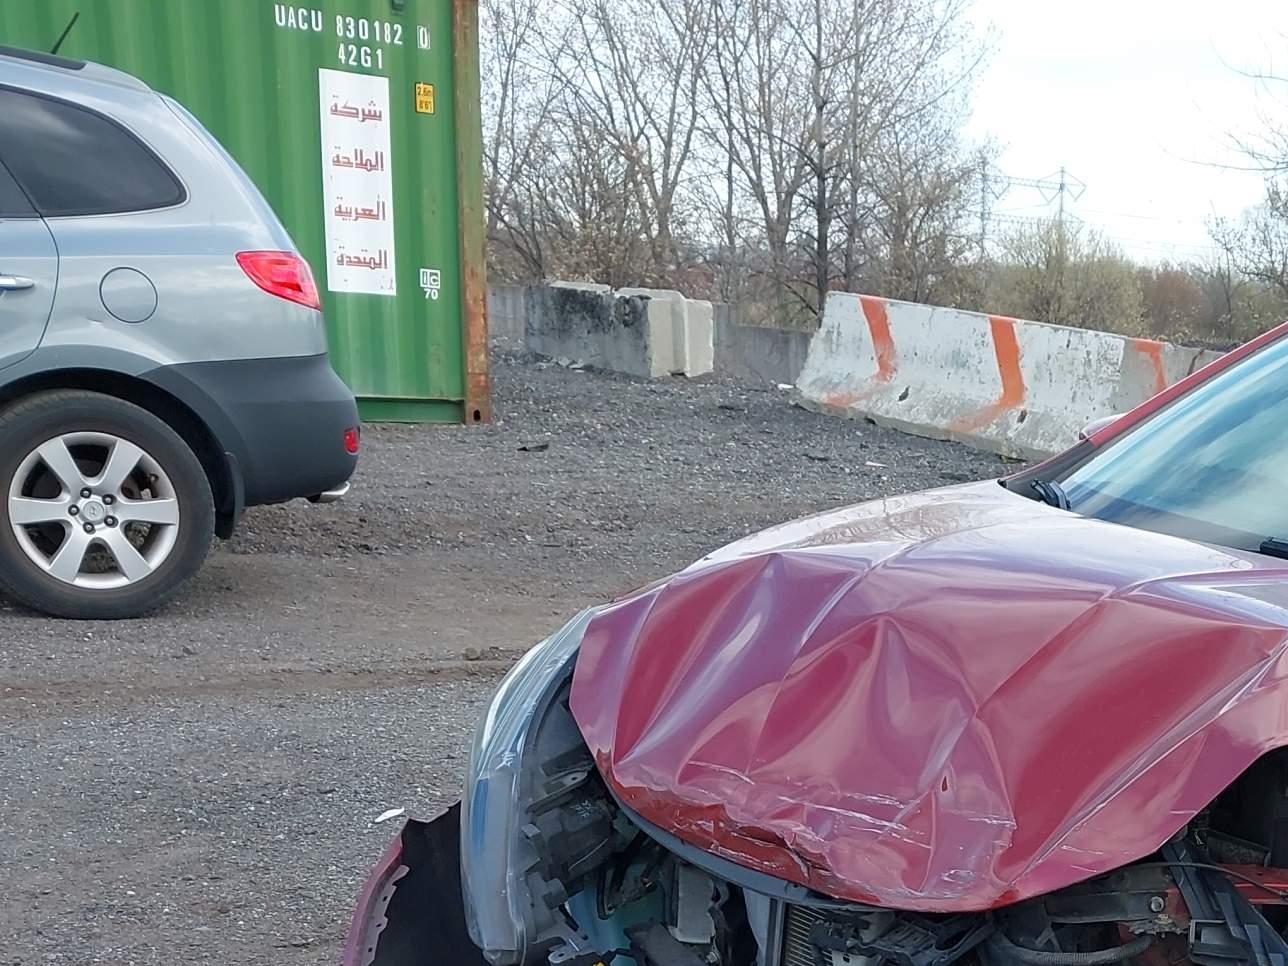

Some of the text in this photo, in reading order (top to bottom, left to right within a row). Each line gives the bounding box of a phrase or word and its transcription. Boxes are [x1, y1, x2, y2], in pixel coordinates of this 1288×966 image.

[275, 4, 323, 32] UACU
[336, 15, 403, 45] 830182
[338, 43, 383, 69] 42G1
[330, 95, 382, 122] شركة
[332, 146, 384, 171] الملاحة
[334, 195, 386, 221] العربية
[336, 246, 388, 270] المتحدة
[424, 288, 439, 300] 70
